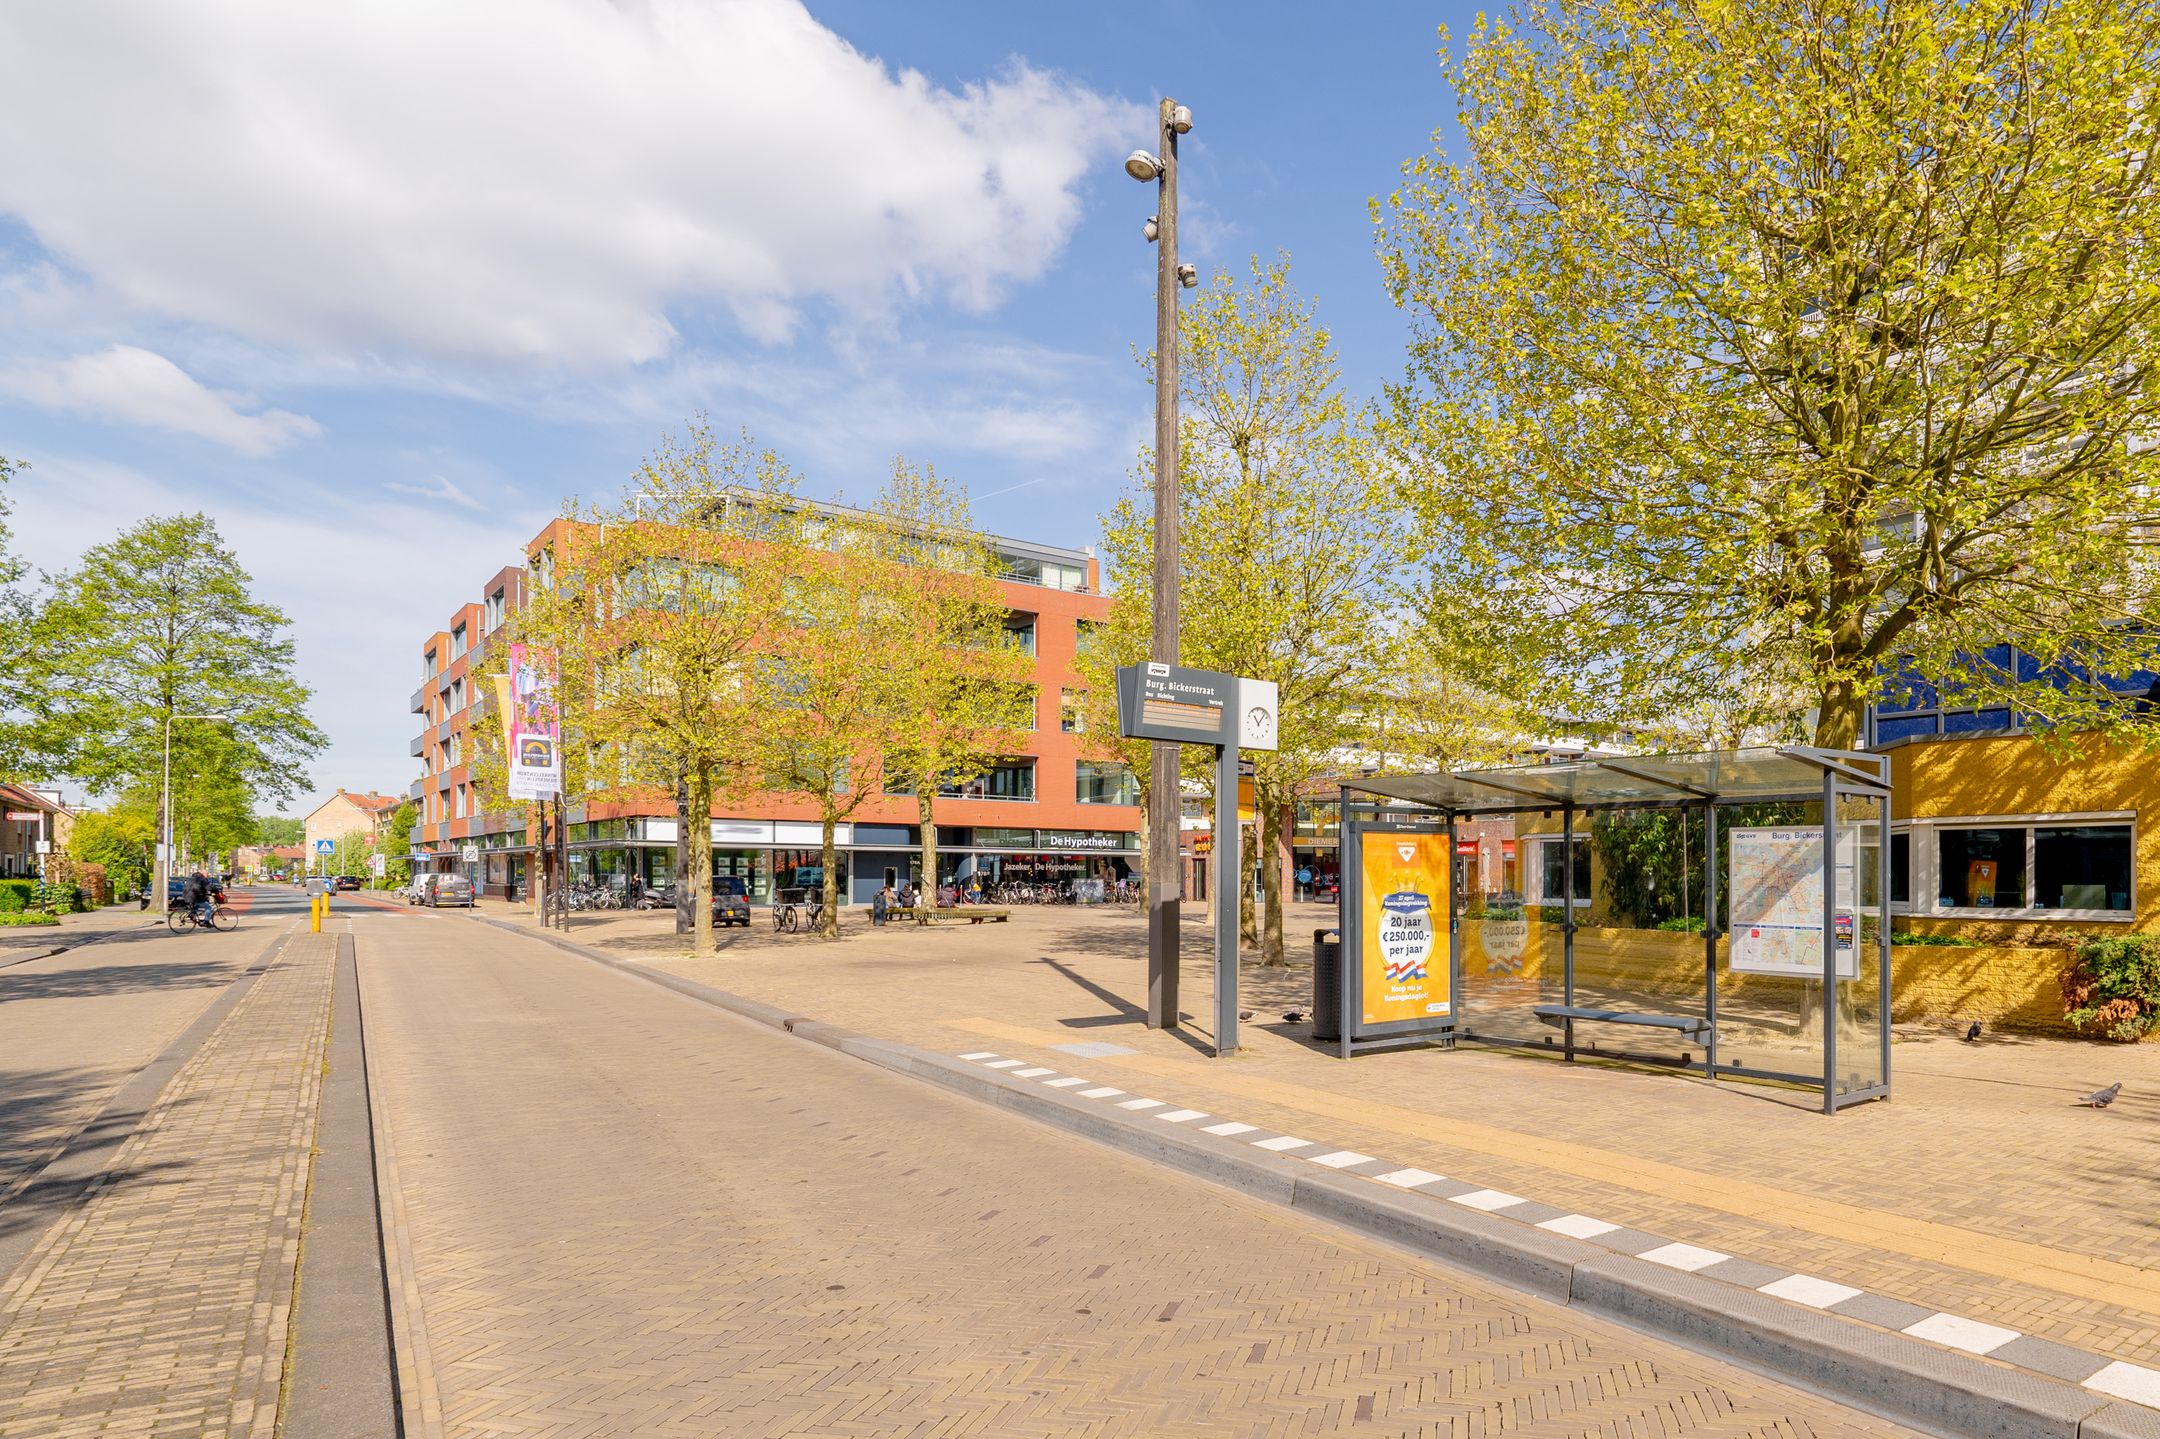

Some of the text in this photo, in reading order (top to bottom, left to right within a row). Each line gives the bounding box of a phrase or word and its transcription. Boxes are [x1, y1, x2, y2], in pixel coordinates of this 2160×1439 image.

[1146, 679, 1215, 695] Burg. Bickerstraat
[1050, 836, 1117, 848] De Hypotheker
[1771, 832, 1792, 840] Burg.
[1003, 862, 1032, 871] Jazeker.
[1045, 864, 1087, 872] Hypotheker.
[1391, 917, 1422, 929] 20 jaar
[1389, 944, 1423, 957] per jaar
[1391, 984, 1406, 993] Koop
